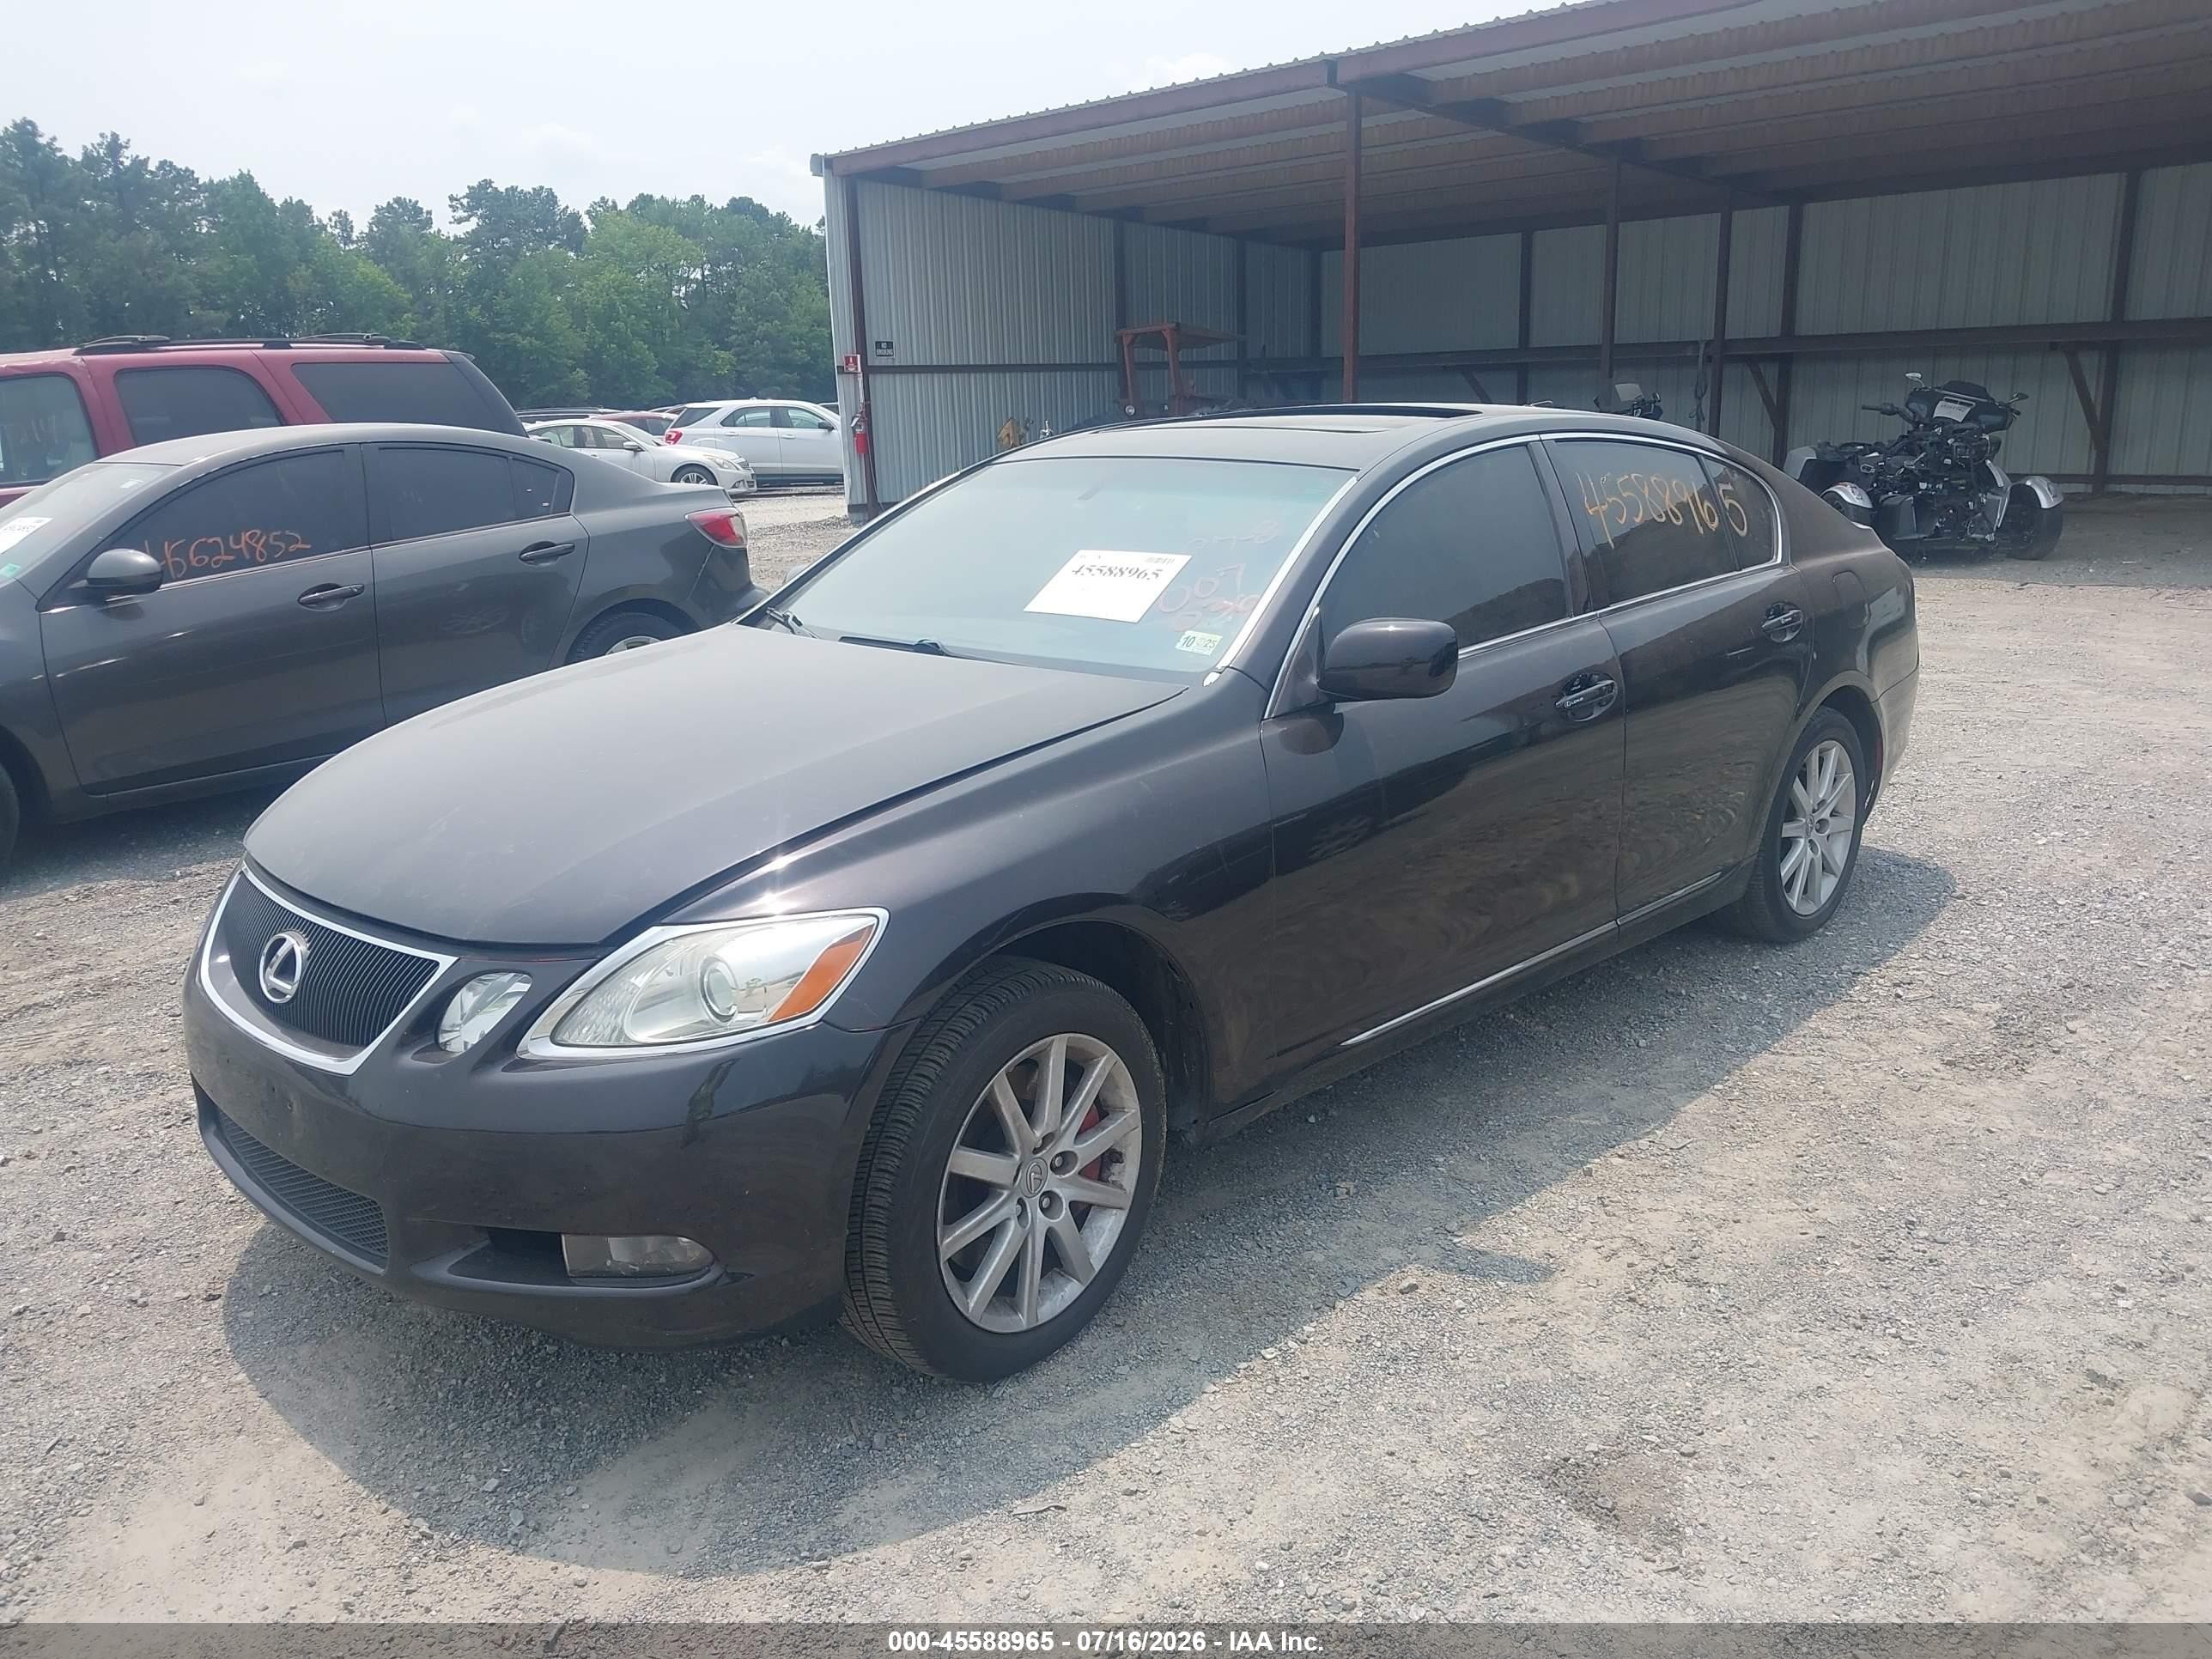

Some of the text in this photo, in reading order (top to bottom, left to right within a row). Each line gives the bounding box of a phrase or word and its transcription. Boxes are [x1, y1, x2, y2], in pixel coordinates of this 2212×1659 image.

[1577, 472, 1747, 550] 45588965
[144, 529, 312, 580] 45624852
[1072, 564, 1164, 580] 45588965
[1182, 635, 1196, 647] 10
[1203, 639, 1218, 649] 25
